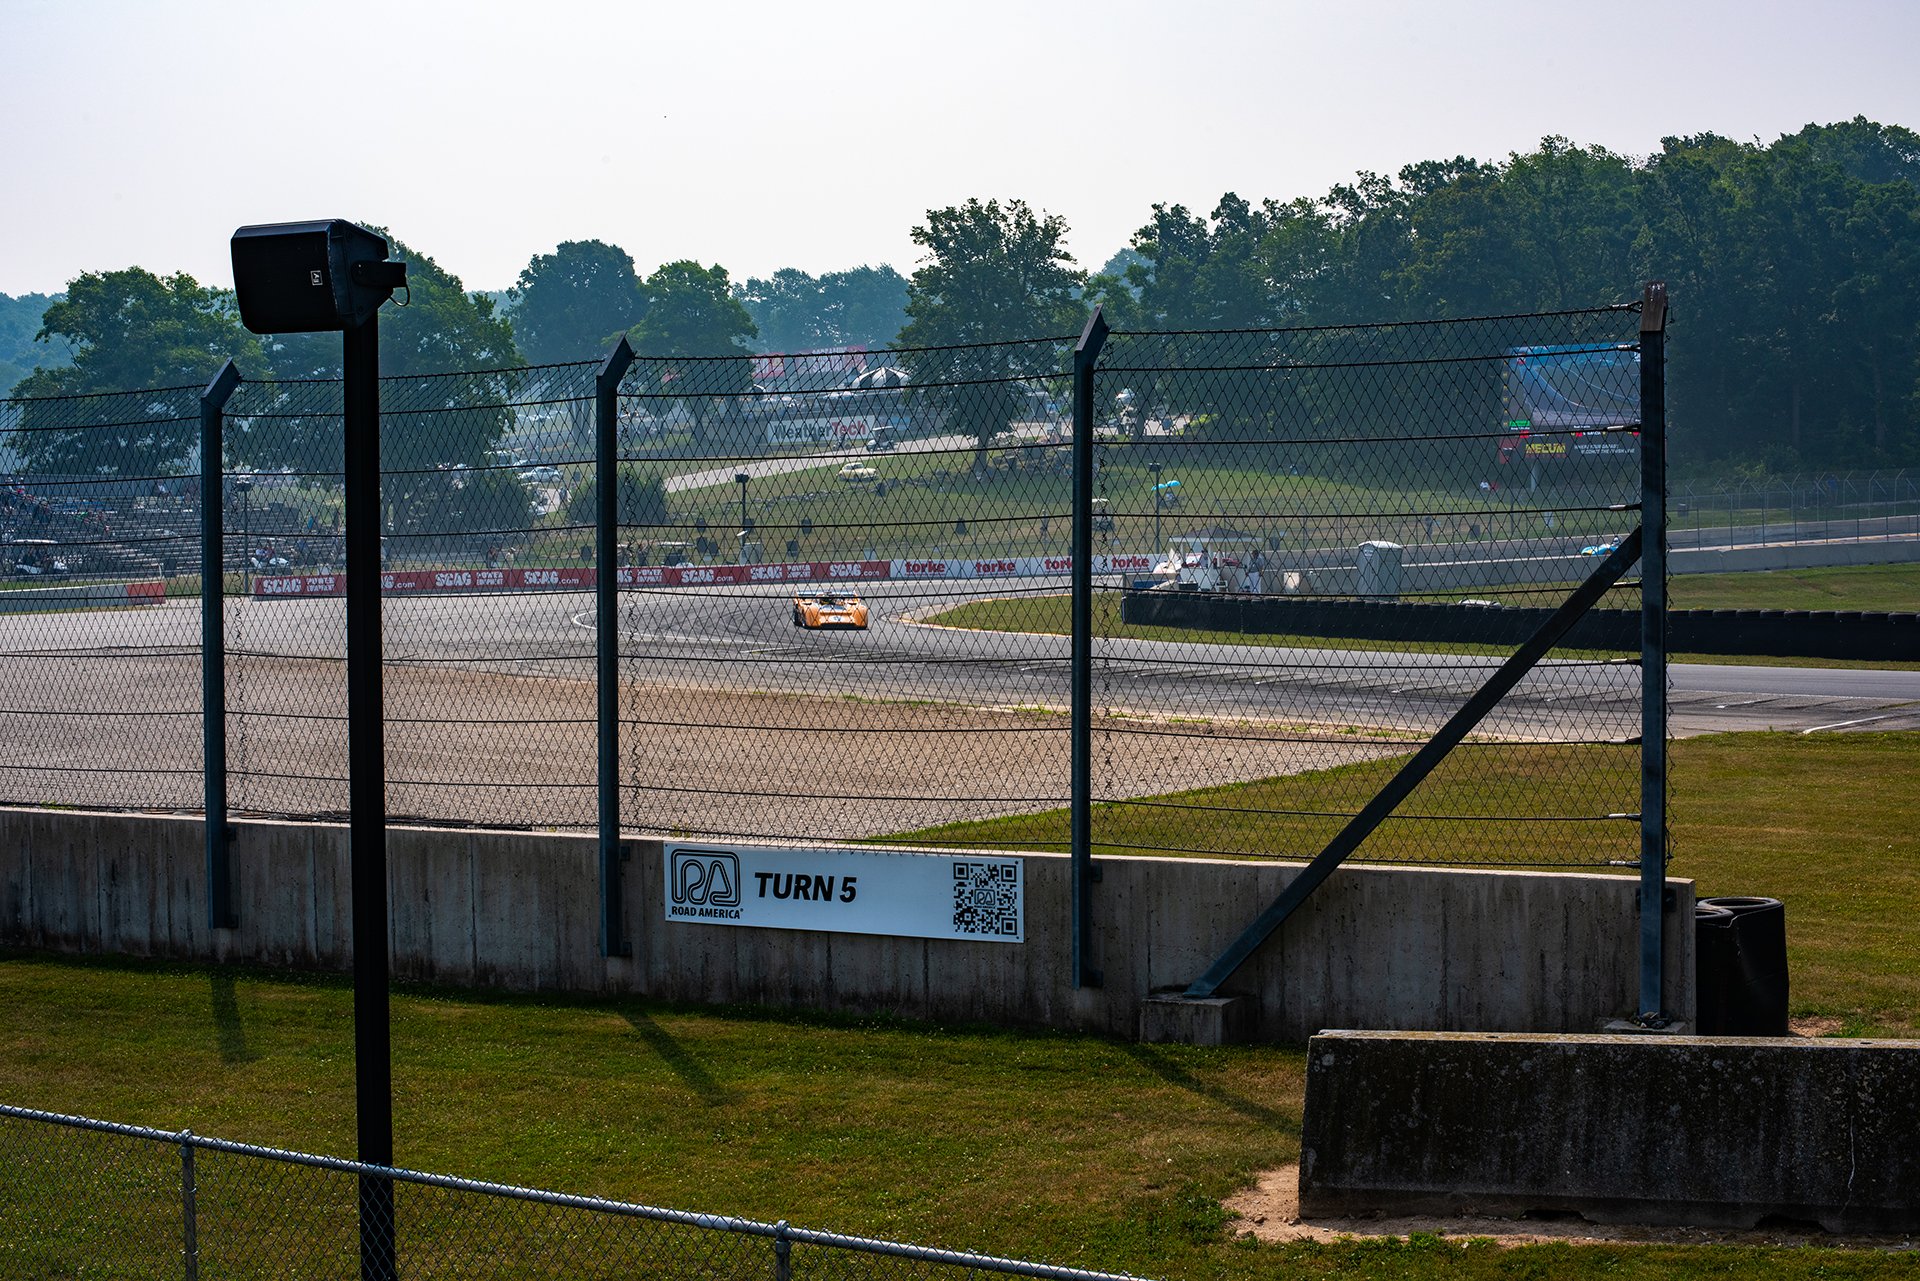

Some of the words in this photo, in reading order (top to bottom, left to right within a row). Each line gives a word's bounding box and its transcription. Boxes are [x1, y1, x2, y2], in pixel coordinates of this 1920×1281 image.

[773, 420, 866, 439] WeatherTech
[1525, 443, 1566, 454] MECUM
[905, 561, 946, 573] torke
[976, 560, 1016, 573] torke
[1111, 556, 1150, 568] torke
[435, 572, 471, 586] SCAG
[750, 566, 782, 580] SCAG
[263, 578, 301, 594] SCAG
[754, 872, 834, 901] TURN
[839, 877, 857, 903] 5
[671, 906, 697, 917] ROAD
